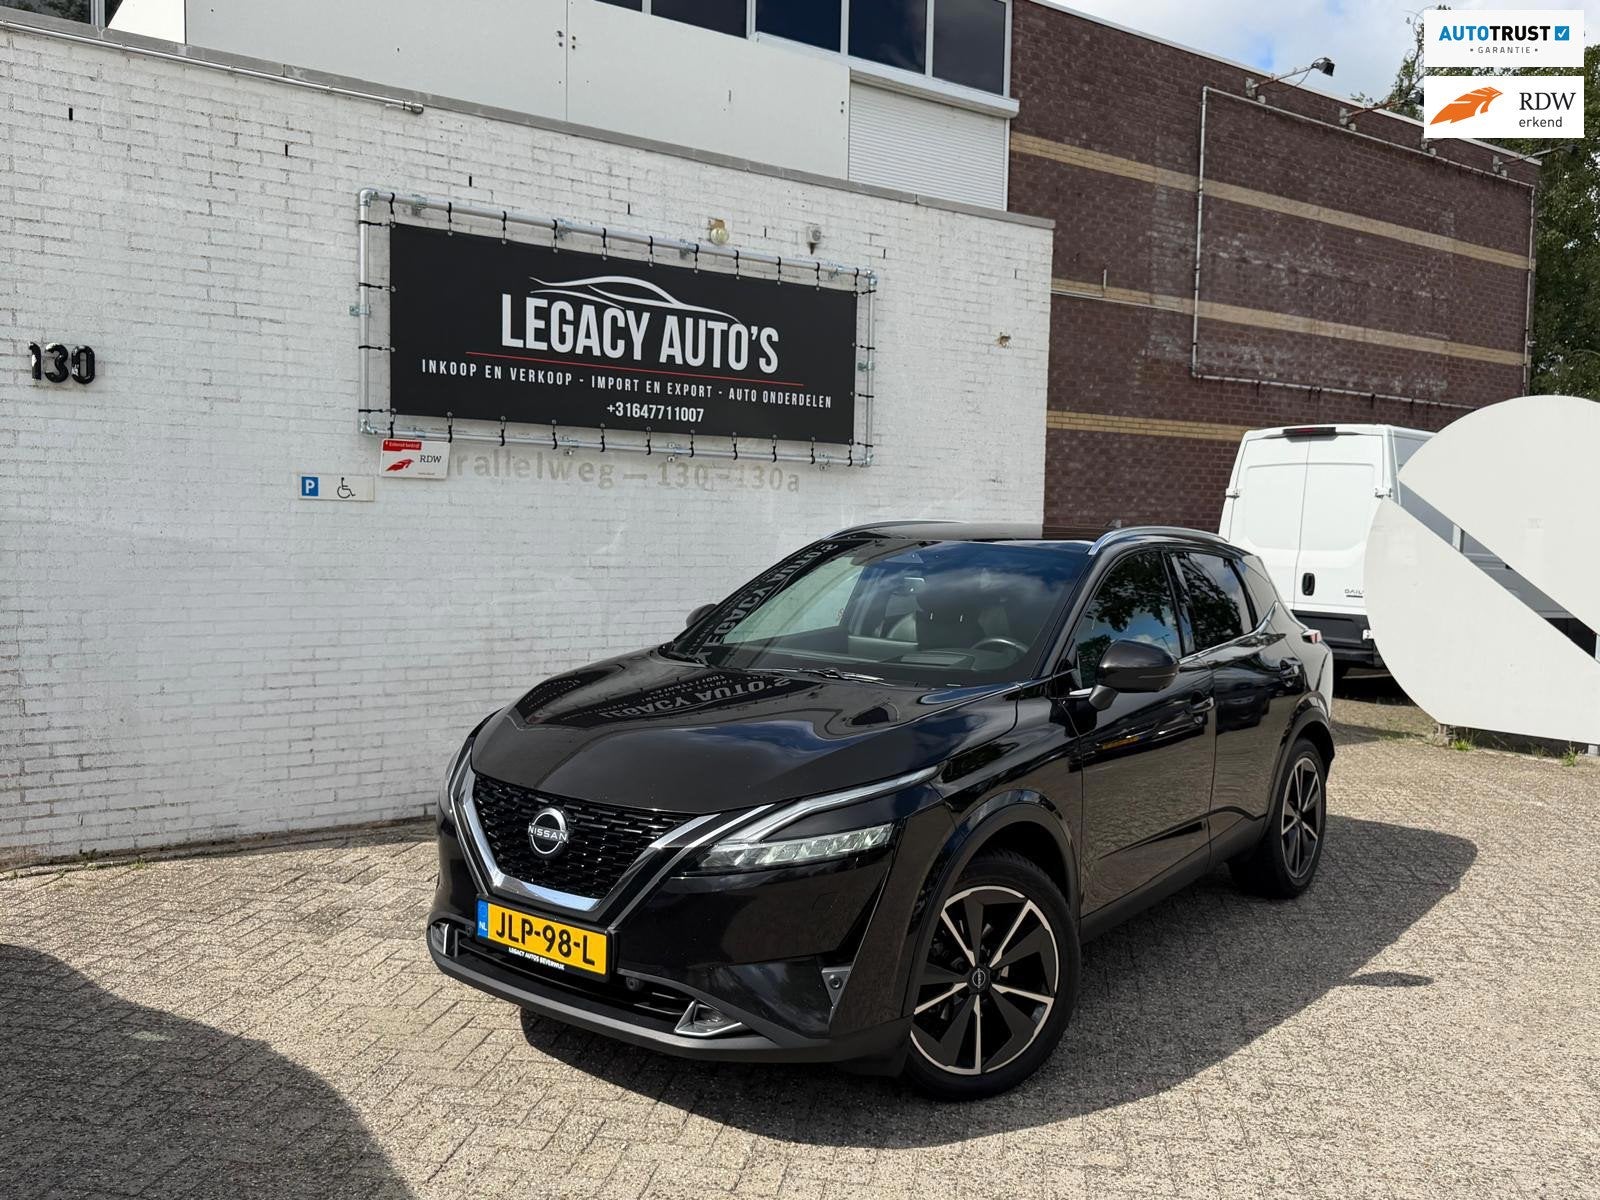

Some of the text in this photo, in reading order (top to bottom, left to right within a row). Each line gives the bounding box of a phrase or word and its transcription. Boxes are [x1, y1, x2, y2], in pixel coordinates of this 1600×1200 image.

[502, 293, 779, 374] LEGACY AUTO'S
[28, 341, 96, 385] 130
[421, 358, 477, 377] INKOOP
[485, 364, 502, 380] EN
[510, 367, 573, 386] VERKOOP
[591, 374, 640, 393] IMPORT
[646, 380, 660, 394] EN
[667, 382, 713, 398] EXPORT
[729, 387, 757, 402] AUTO
[762, 390, 832, 408] ONDERDELEN
[607, 401, 704, 423] +31647711007
[419, 454, 442, 464] RDW
[456, 448, 615, 490] rallelweg
[305, 478, 316, 494] P
[528, 825, 569, 843] NISSAN
[479, 920, 487, 931] NL
[496, 912, 596, 966] JLP-98-L
